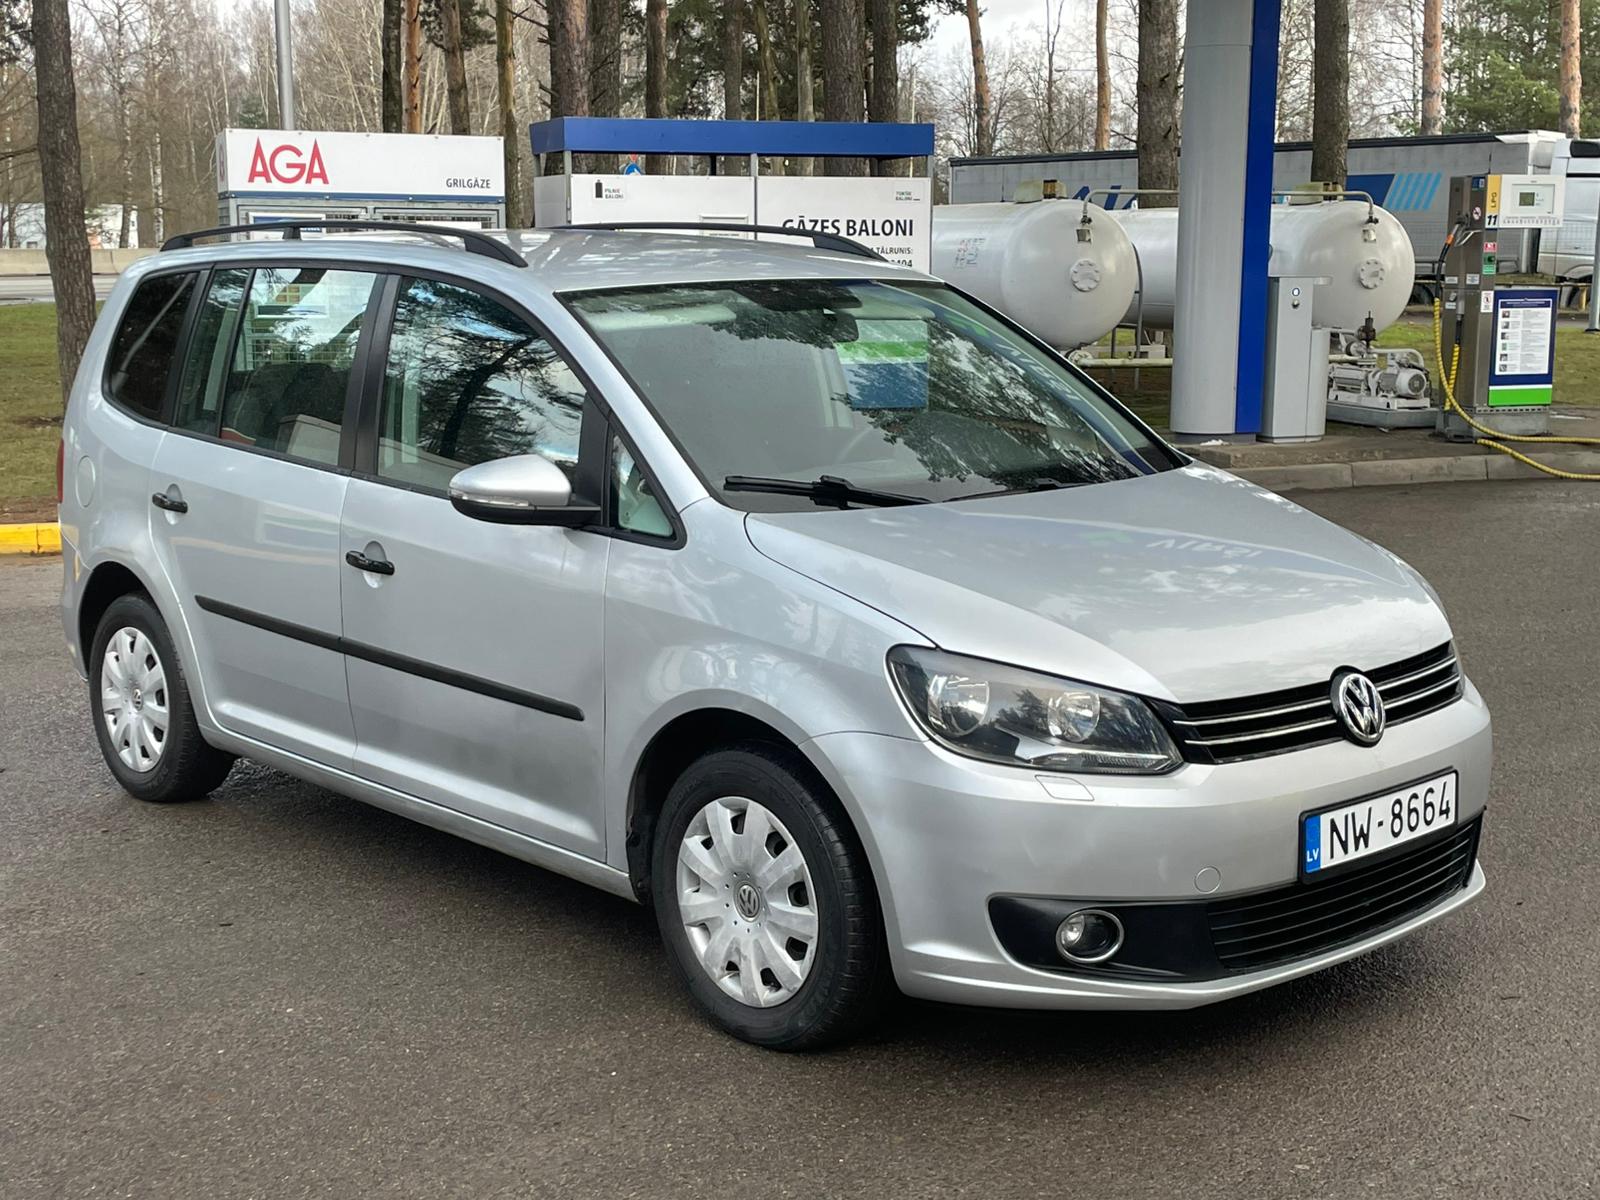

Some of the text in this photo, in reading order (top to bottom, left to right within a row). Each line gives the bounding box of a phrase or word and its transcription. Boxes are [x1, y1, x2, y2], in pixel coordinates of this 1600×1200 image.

[248, 137, 329, 185] AGA
[446, 176, 491, 189] GRILGĀZE
[846, 219, 914, 237] BALONI
[1487, 214, 1498, 226] 11
[1329, 782, 1451, 860] NW-8664
[1306, 848, 1319, 862] LV
